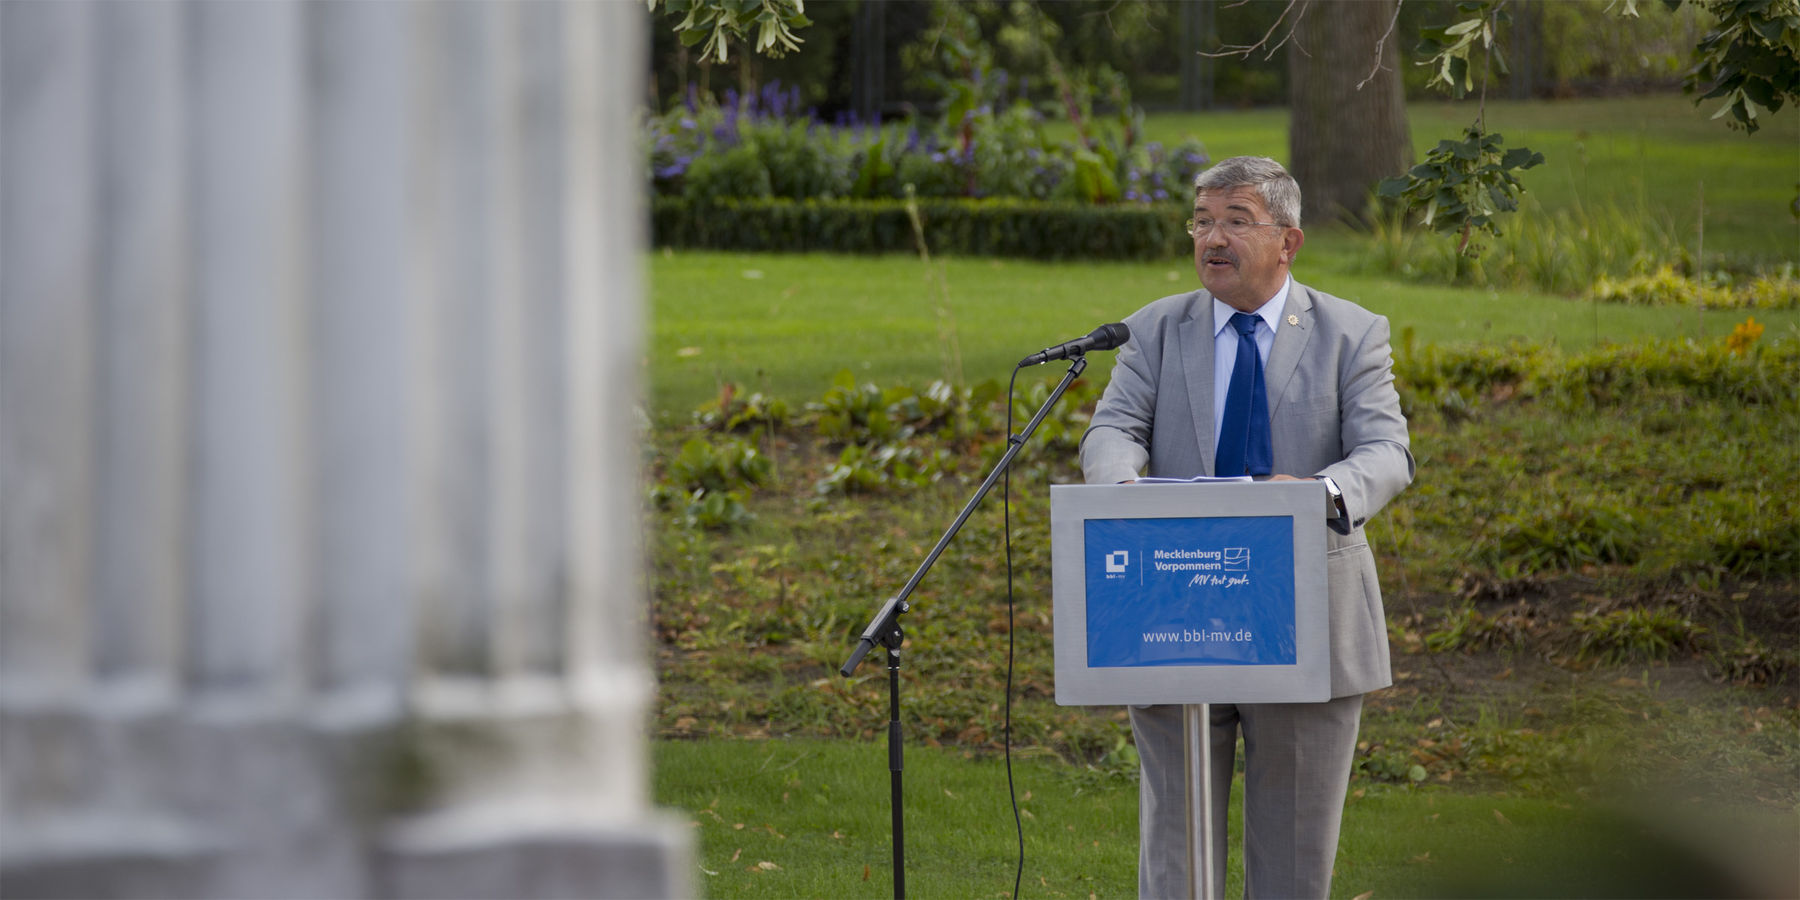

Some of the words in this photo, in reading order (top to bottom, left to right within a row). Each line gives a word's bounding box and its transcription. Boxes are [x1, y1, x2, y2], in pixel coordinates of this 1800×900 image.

[1154, 549, 1222, 560] Mecklenburg
[1155, 561, 1222, 572] Vorpommern
[1188, 574, 1211, 587] MV
[1142, 629, 1252, 642] www.bbl-mv.de
